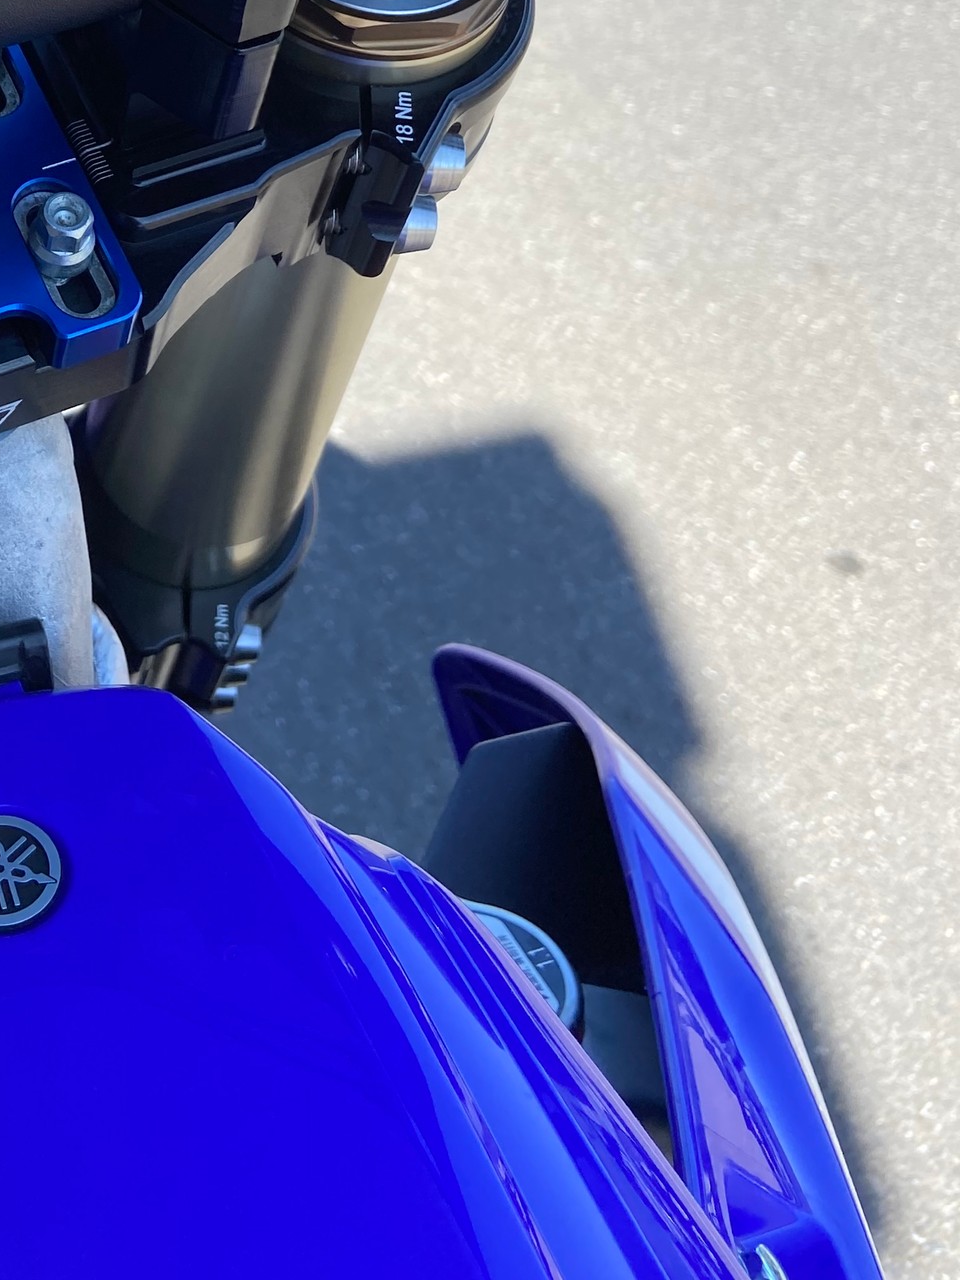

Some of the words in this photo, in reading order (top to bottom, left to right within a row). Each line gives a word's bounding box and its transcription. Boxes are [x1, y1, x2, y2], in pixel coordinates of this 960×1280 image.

[394, 91, 413, 120] Nm
[395, 124, 414, 144] 18
[214, 604, 229, 627] Nm
